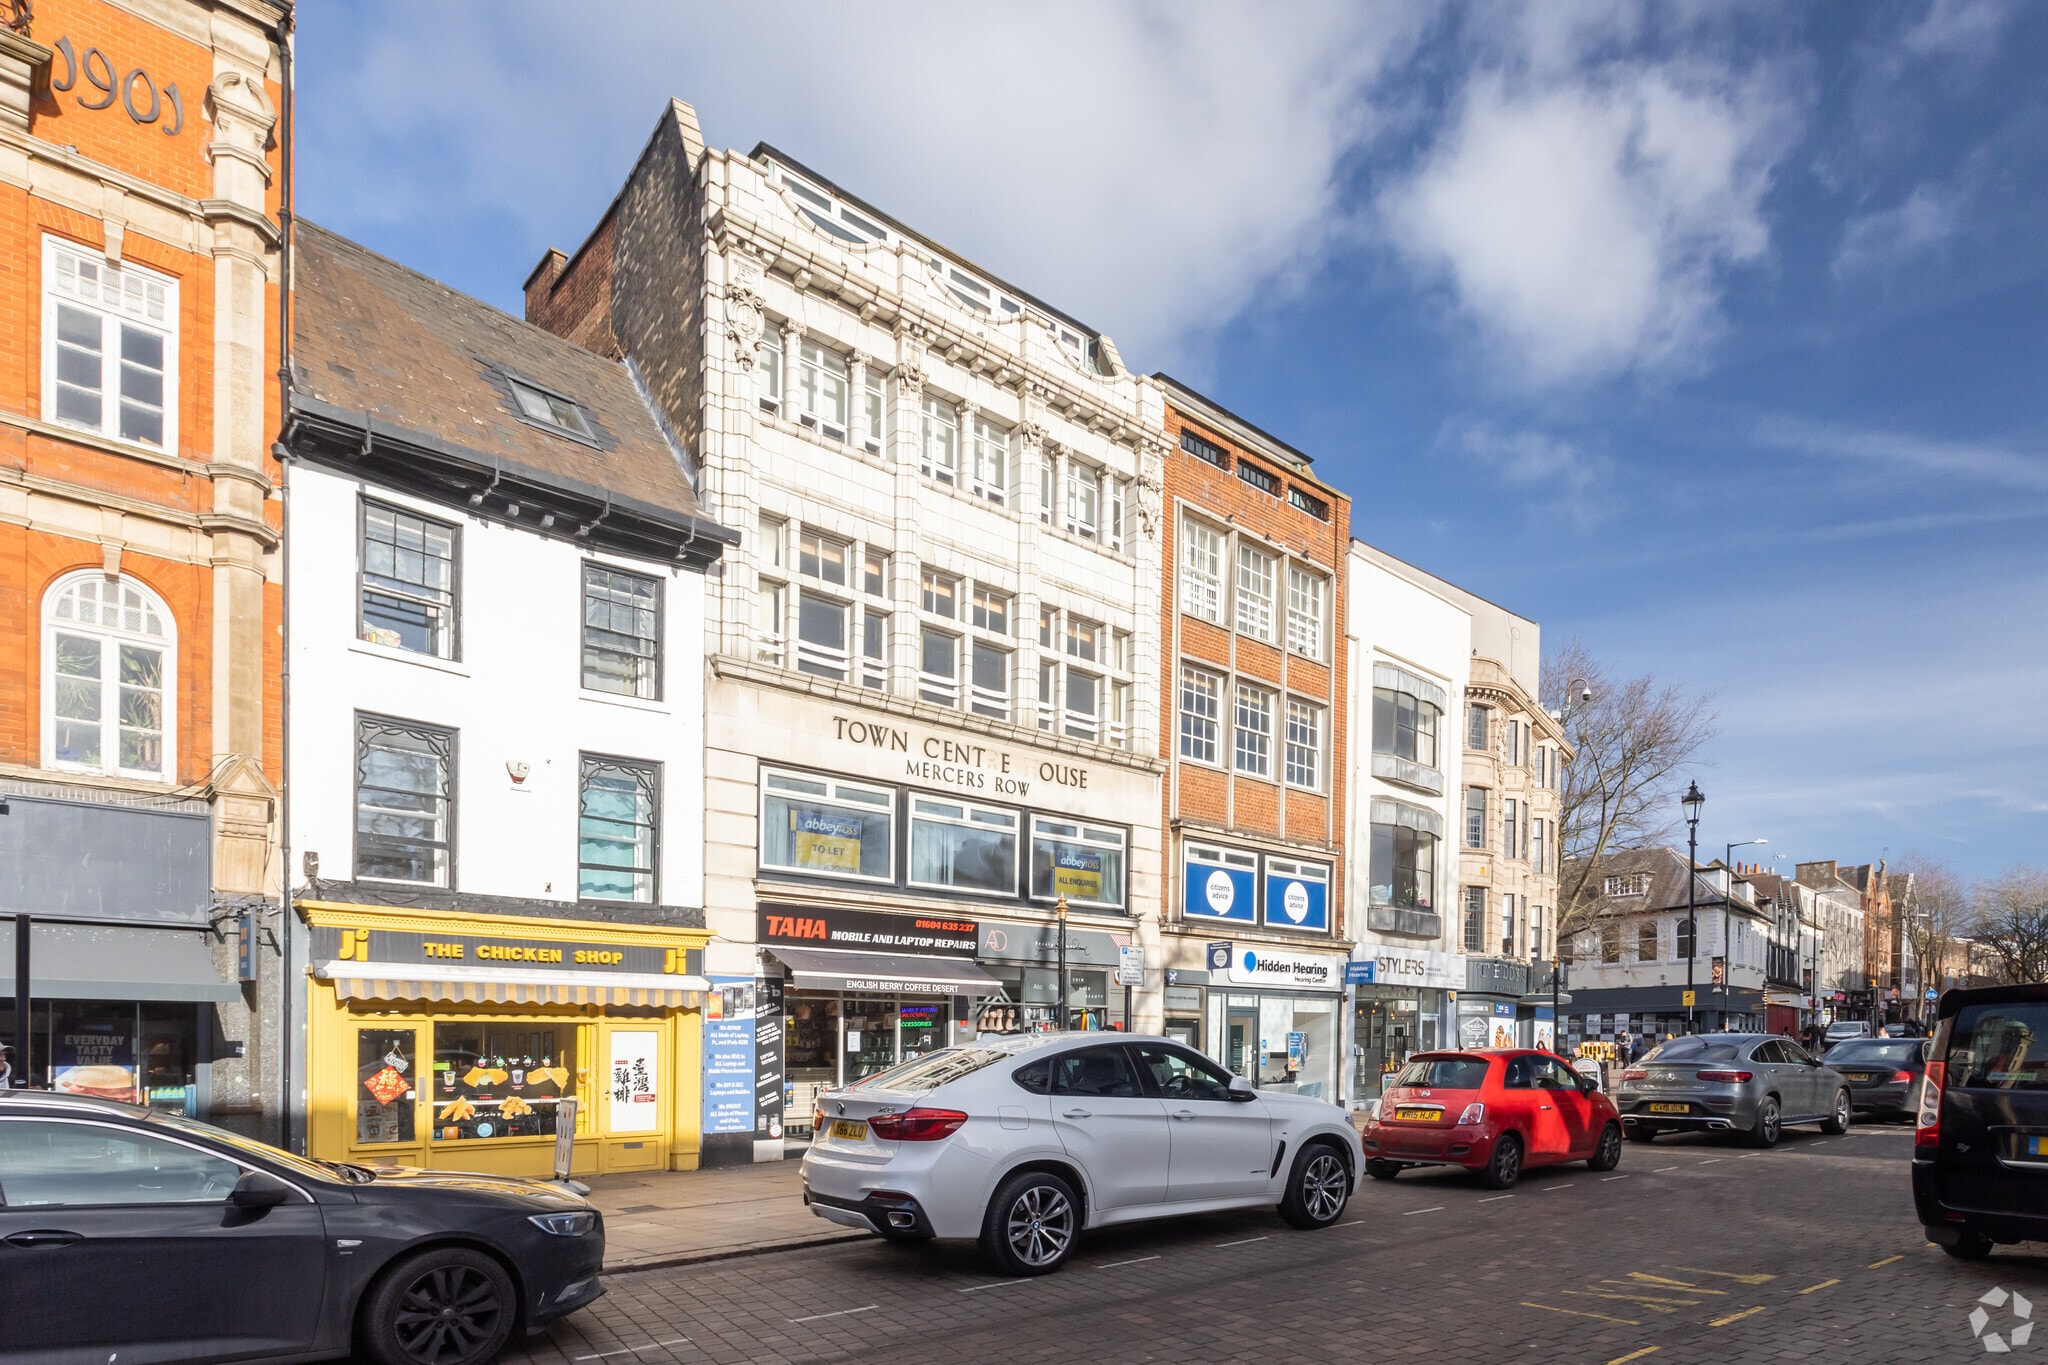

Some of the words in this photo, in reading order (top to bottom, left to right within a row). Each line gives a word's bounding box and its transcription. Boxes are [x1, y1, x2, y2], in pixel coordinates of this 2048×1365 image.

[832, 715, 908, 752] TOWN
[923, 737, 1010, 774] CENTE
[1026, 759, 1088, 789] OUSE
[906, 760, 984, 789] MERCERS
[994, 776, 1030, 797] ROW
[812, 844, 826, 854] TO
[828, 846, 845, 856] LET
[1058, 876, 1068, 884] ALL
[1070, 878, 1098, 888] ENQUIRIES
[1210, 884, 1230, 892] citizens
[1212, 892, 1229, 900] advice
[1288, 894, 1305, 902] citizens
[1289, 902, 1304, 910] advice
[766, 915, 827, 940] TAHA
[915, 919, 942, 930] 01604
[942, 921, 958, 931] 635
[958, 922, 976, 932] 237
[339, 928, 370, 962] Ji
[831, 930, 871, 943] MOBILE
[872, 934, 894, 944] AND
[894, 935, 934, 947] LAPTOP
[934, 938, 976, 950] REPAIRS
[424, 942, 464, 958] THE
[476, 944, 562, 963] CHICKEN
[574, 950, 624, 966] SHOP
[663, 948, 687, 974] Ji
[1378, 956, 1425, 976] STYLERS
[1257, 958, 1291, 973] Hidden
[1293, 962, 1328, 978] Hearing
[846, 980, 878, 990] ENGLISH
[879, 982, 900, 991] BERRY
[904, 983, 932, 992] COFFEE
[932, 984, 958, 993] DESERT
[1294, 976, 1312, 984] Hearing
[65, 1035, 125, 1045] EVERYDAY
[76, 1046, 114, 1055] TASTY
[76, 1056, 113, 1065] VALUE
